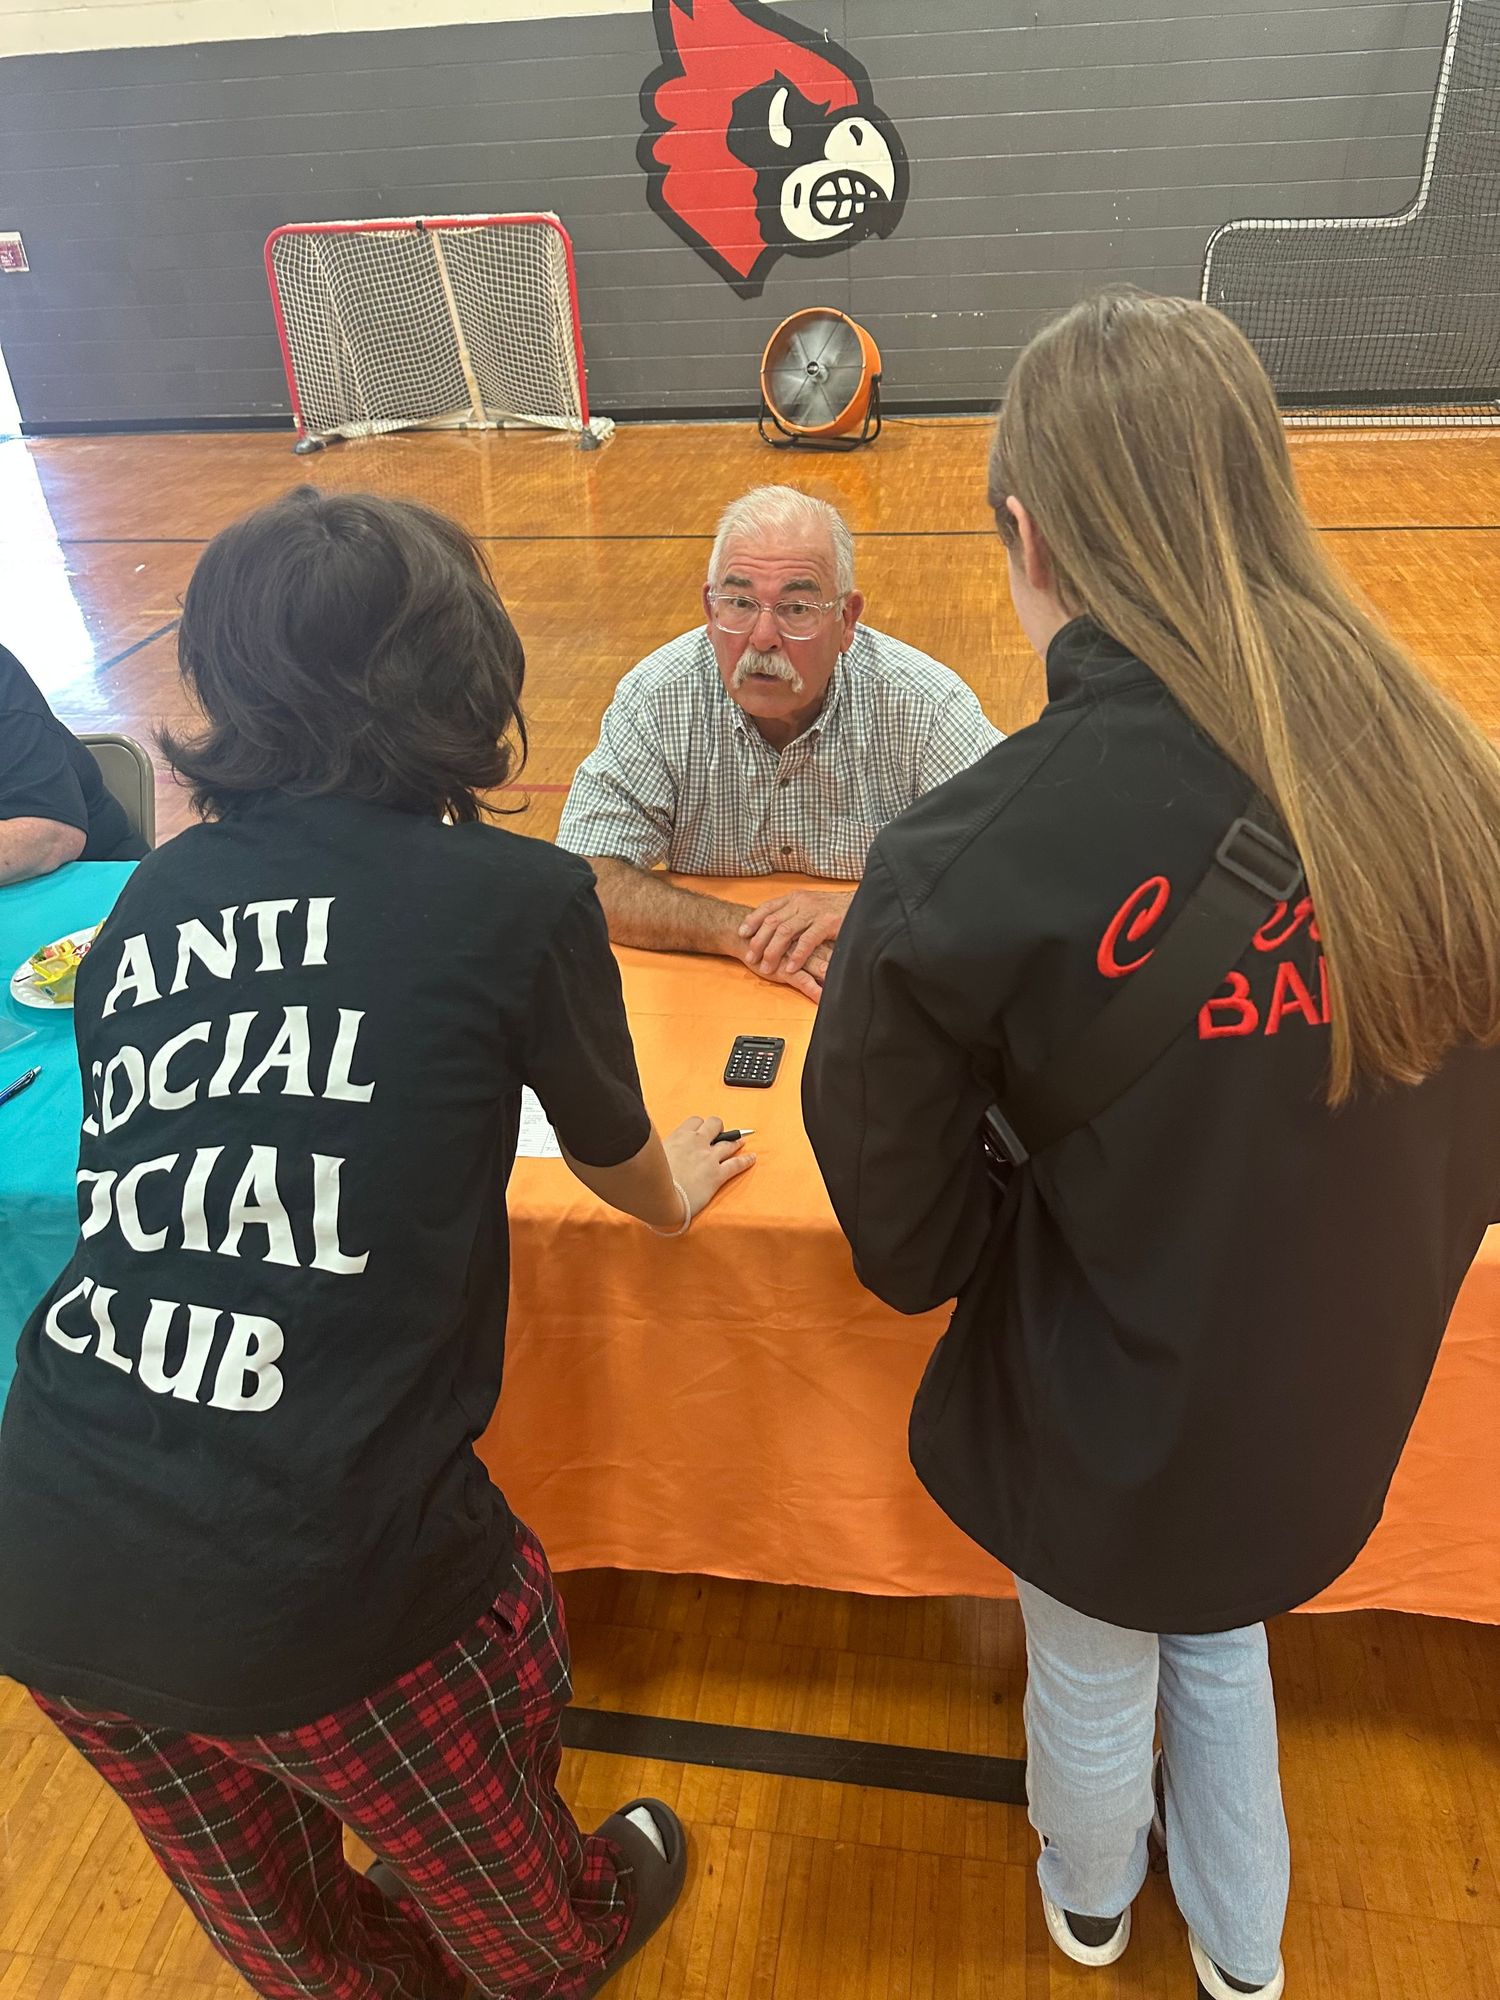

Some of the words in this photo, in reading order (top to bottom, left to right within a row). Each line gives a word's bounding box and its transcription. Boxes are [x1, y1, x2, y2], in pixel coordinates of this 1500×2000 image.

[102, 897, 336, 1018] ANTI
[76, 1144, 370, 1275] OCIAL
[45, 1277, 285, 1412] CLUB
